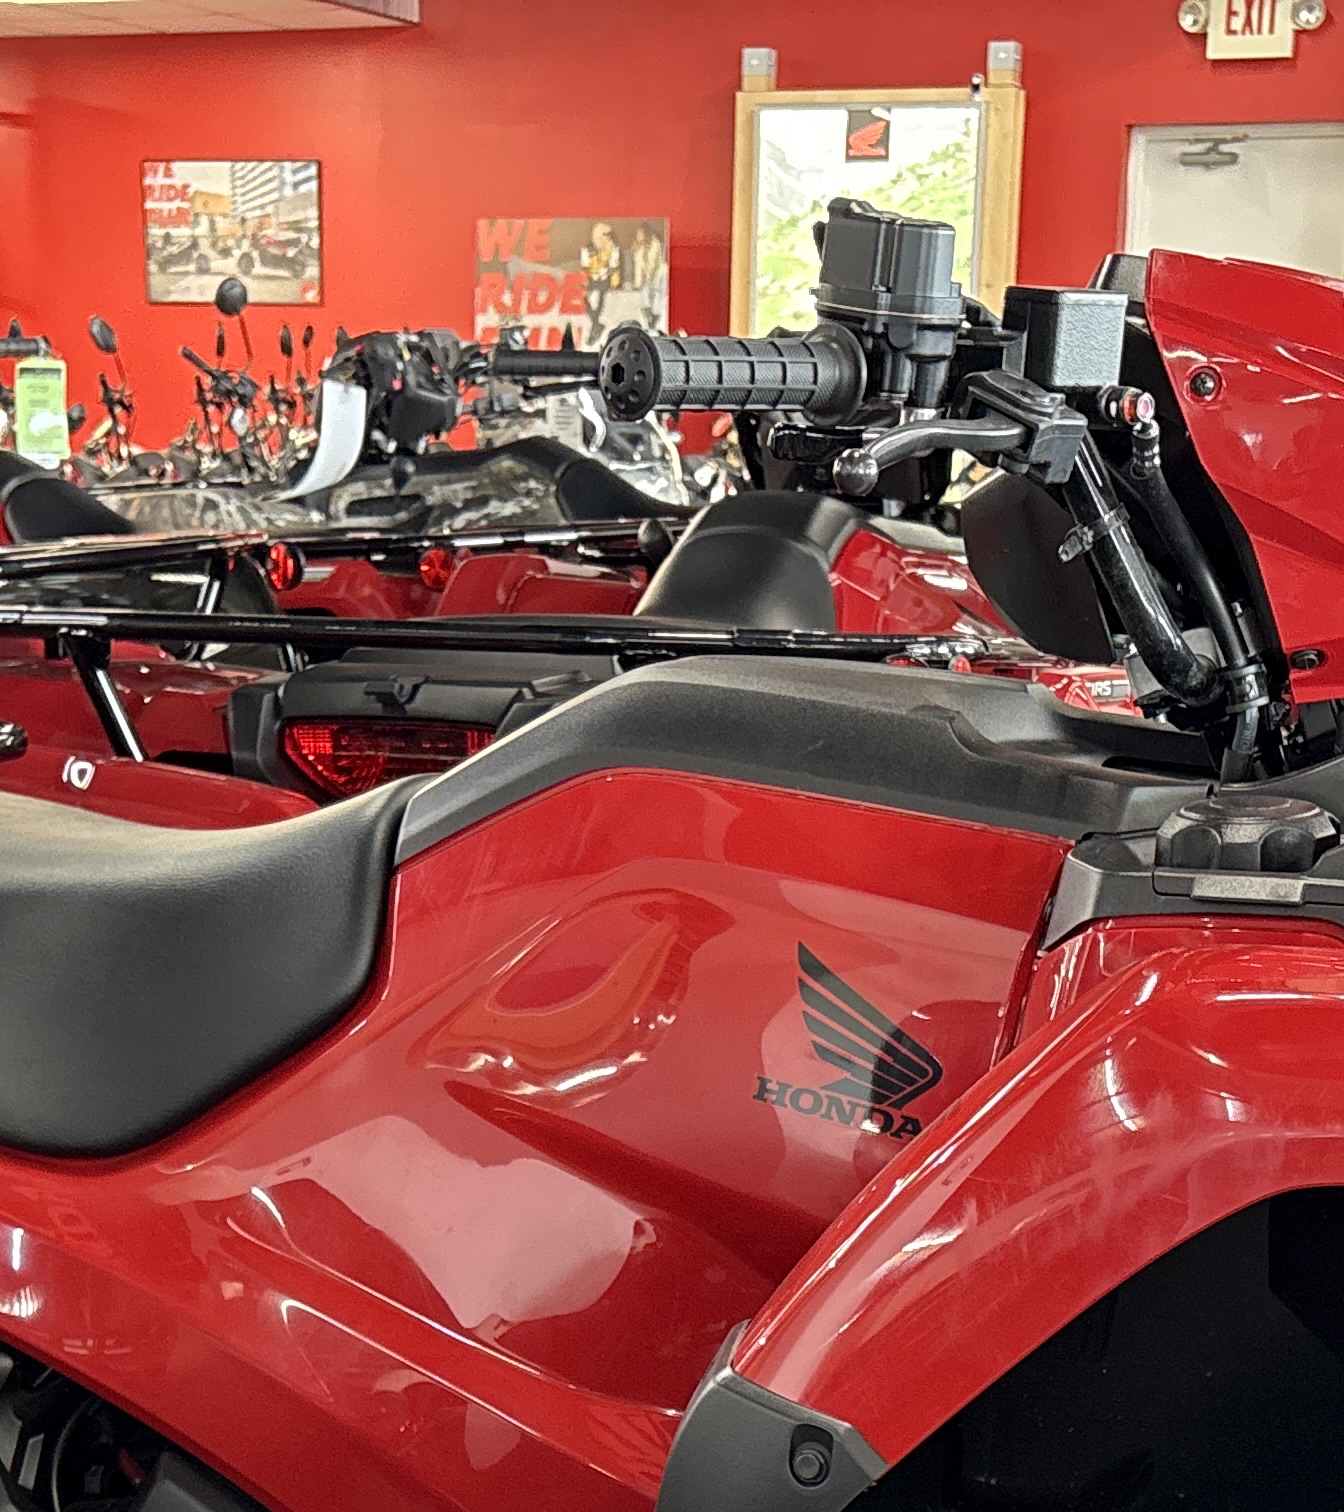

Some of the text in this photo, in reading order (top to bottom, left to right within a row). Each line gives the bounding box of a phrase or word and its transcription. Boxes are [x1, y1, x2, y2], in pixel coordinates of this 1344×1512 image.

[477, 219, 553, 262] WE
[475, 272, 588, 316] RIDE
[752, 1075, 924, 1141] HONDA
